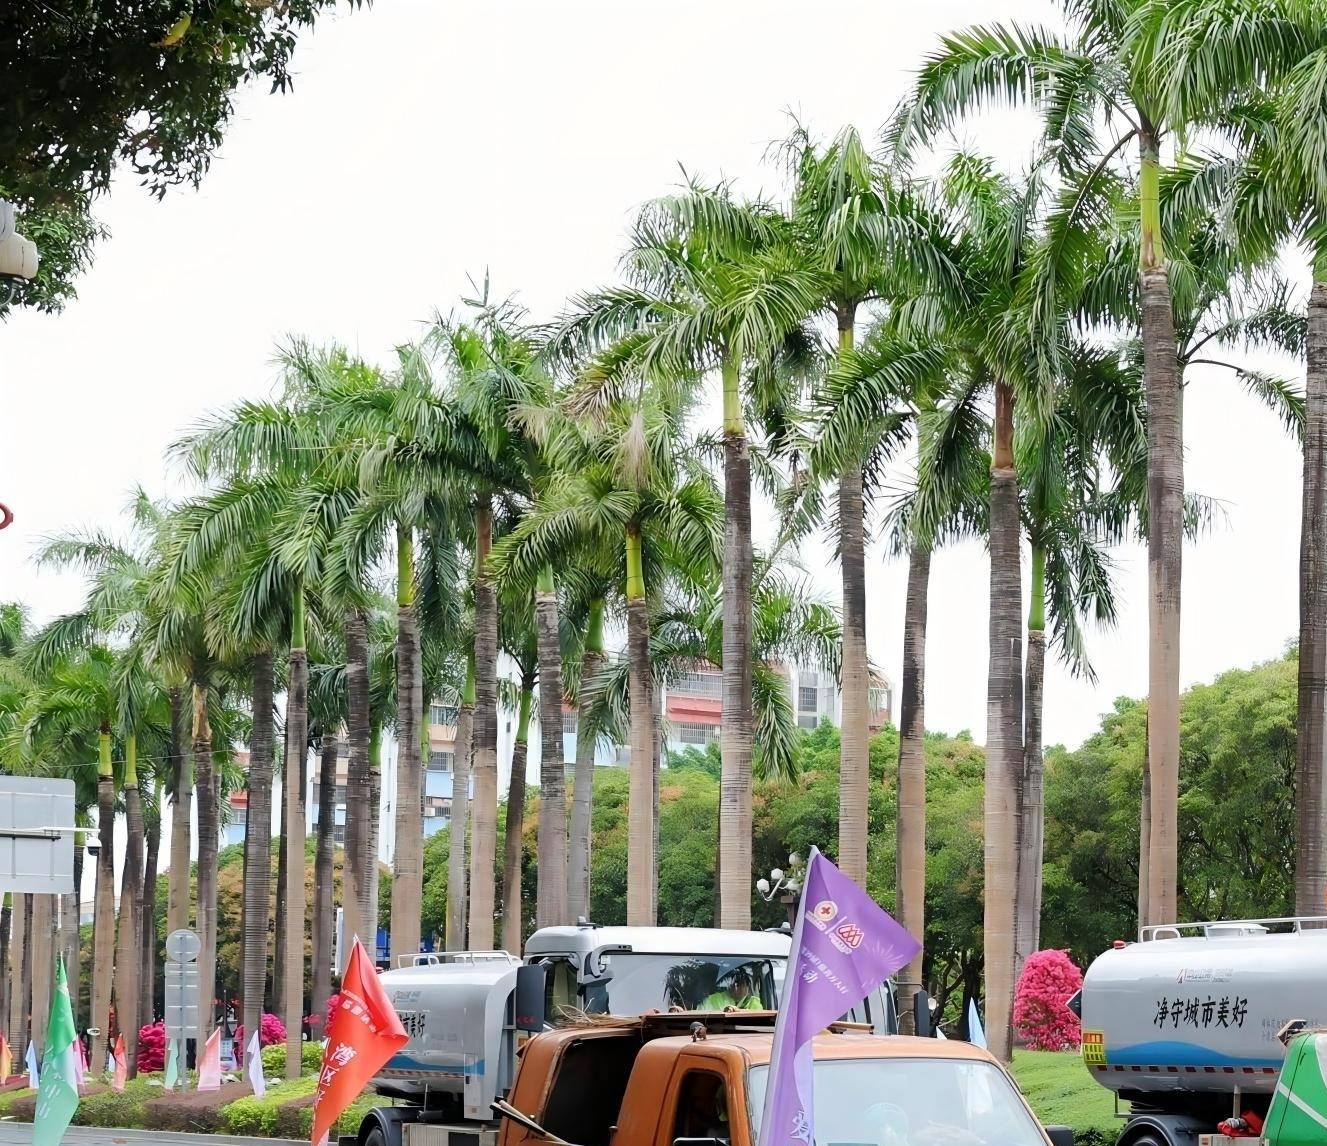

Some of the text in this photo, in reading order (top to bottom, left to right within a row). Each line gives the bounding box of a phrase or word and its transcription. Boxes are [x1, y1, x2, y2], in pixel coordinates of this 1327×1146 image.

[1154, 995, 1248, 1029] 净守城市美好
